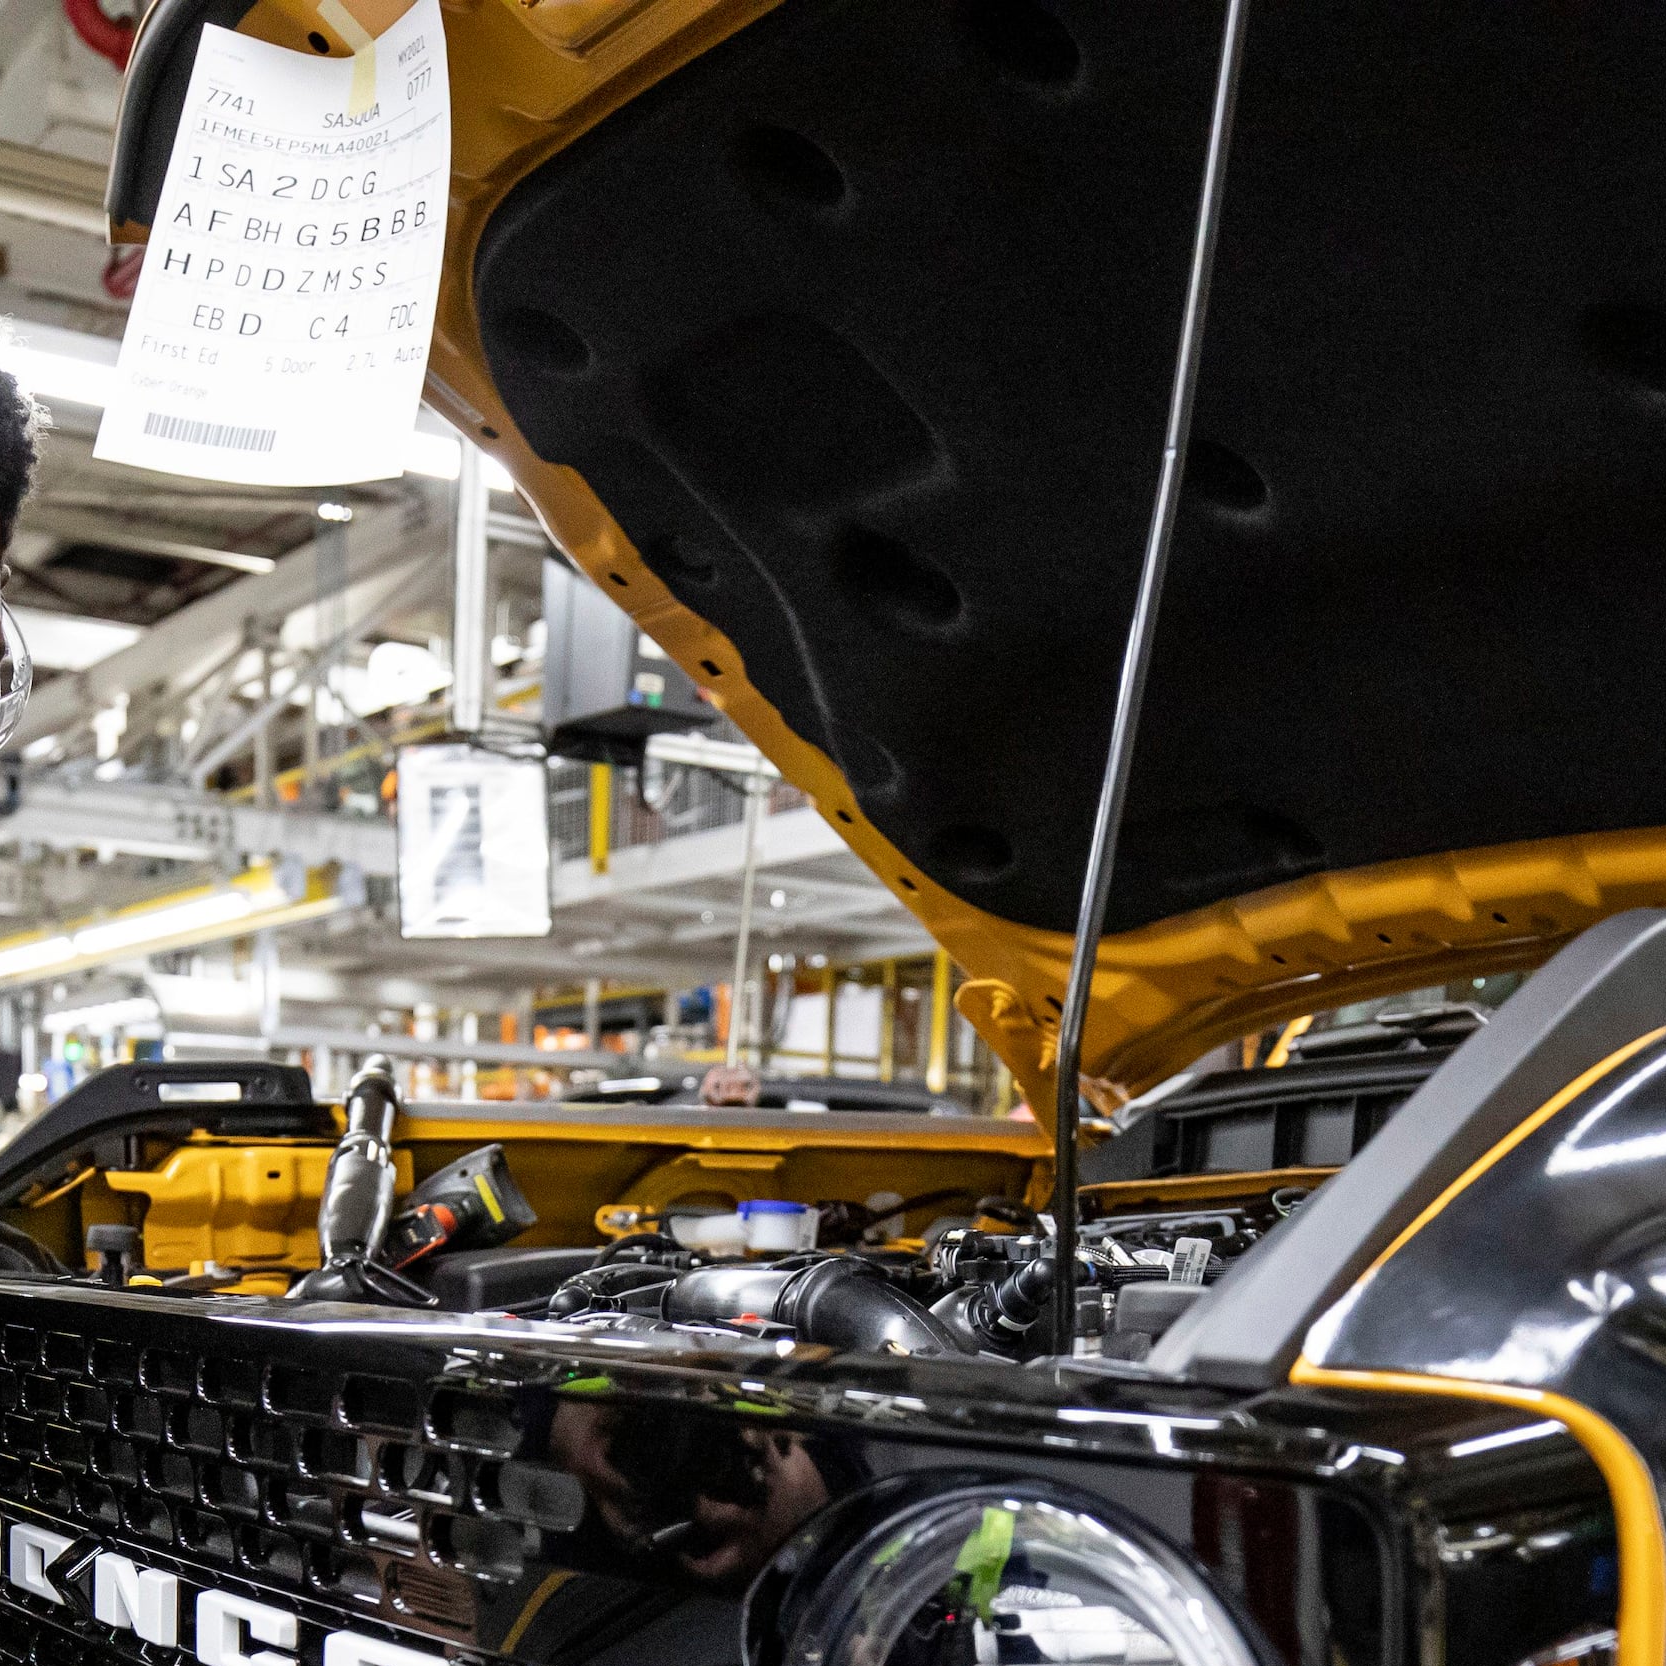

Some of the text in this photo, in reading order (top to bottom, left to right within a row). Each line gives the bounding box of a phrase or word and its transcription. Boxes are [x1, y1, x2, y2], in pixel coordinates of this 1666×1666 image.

[206, 86, 254, 116] 7741
[407, 67, 431, 100] 0777
[188, 156, 376, 200] 1 SA 2 D C G
[173, 200, 426, 247] A F BH G 5 B B B
[163, 248, 388, 293] H P D D Z M S S
[192, 301, 418, 340] EB D C 4 FDC
